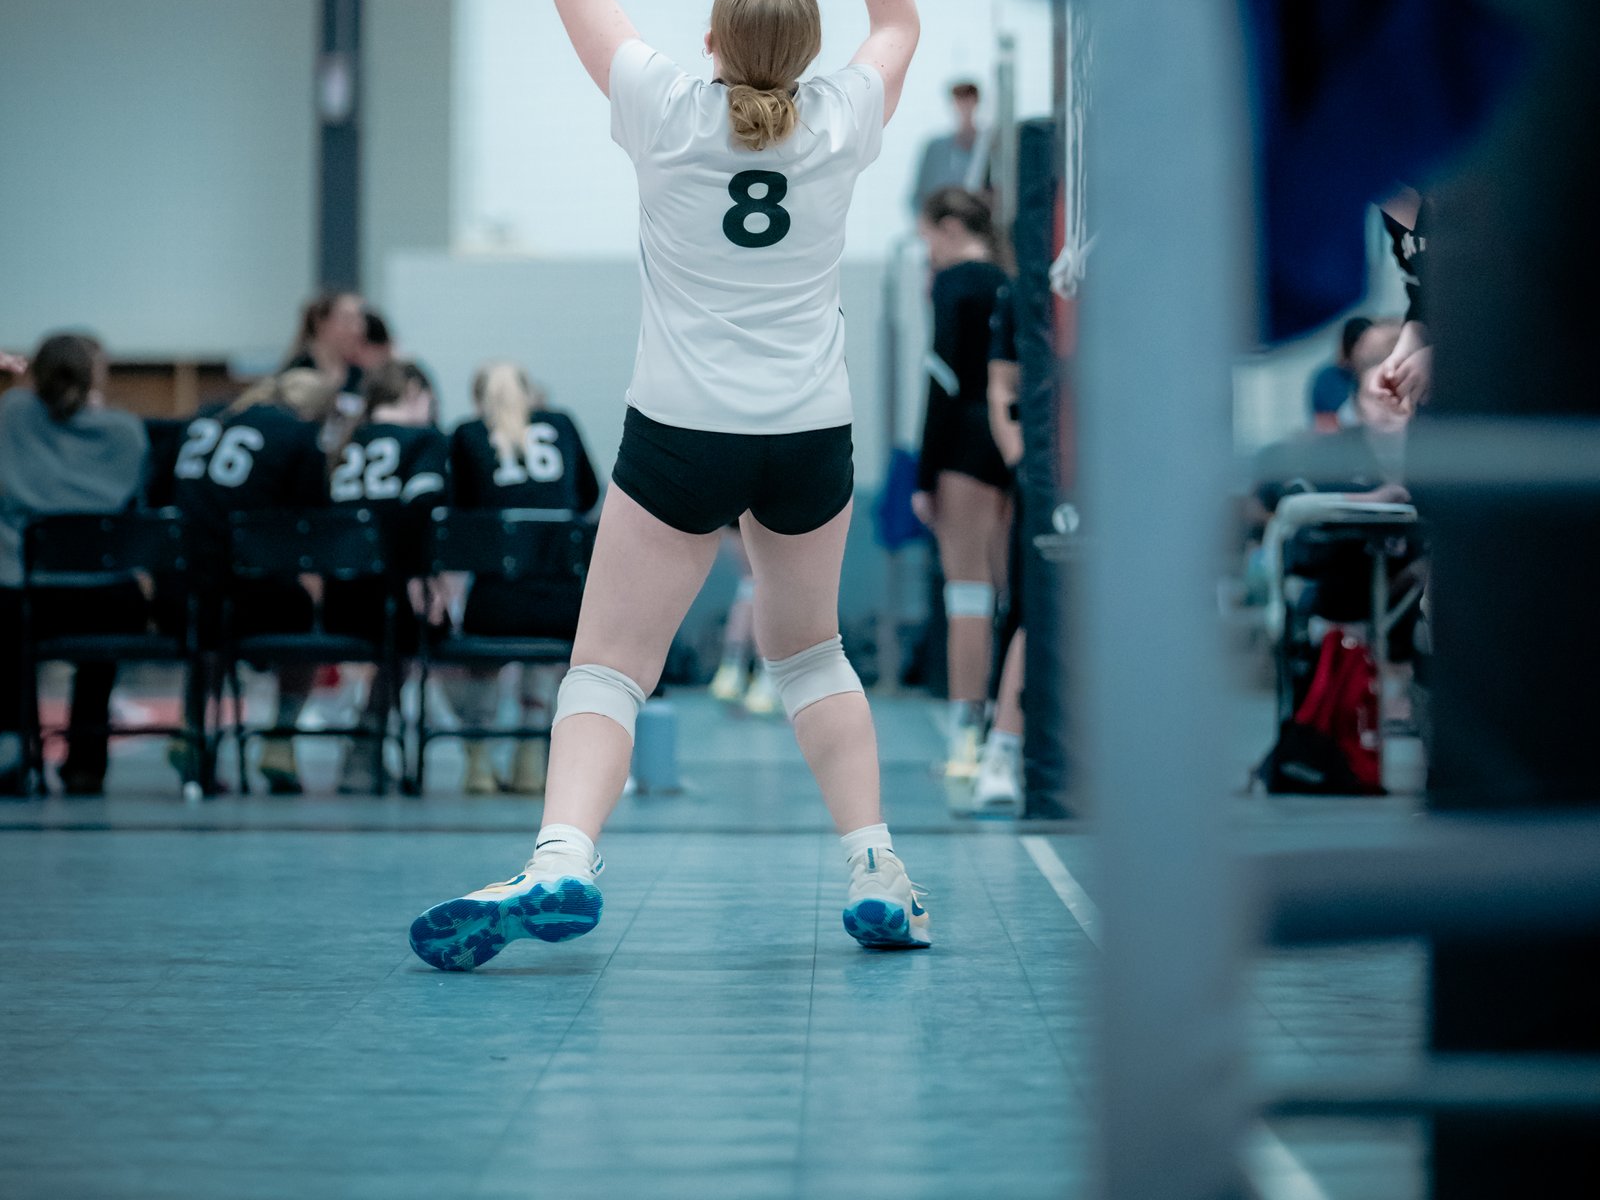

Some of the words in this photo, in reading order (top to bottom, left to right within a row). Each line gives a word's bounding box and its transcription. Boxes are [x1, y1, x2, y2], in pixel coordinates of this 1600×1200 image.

[723, 170, 791, 248] 8
[174, 417, 265, 488] 26
[331, 437, 401, 501] 22
